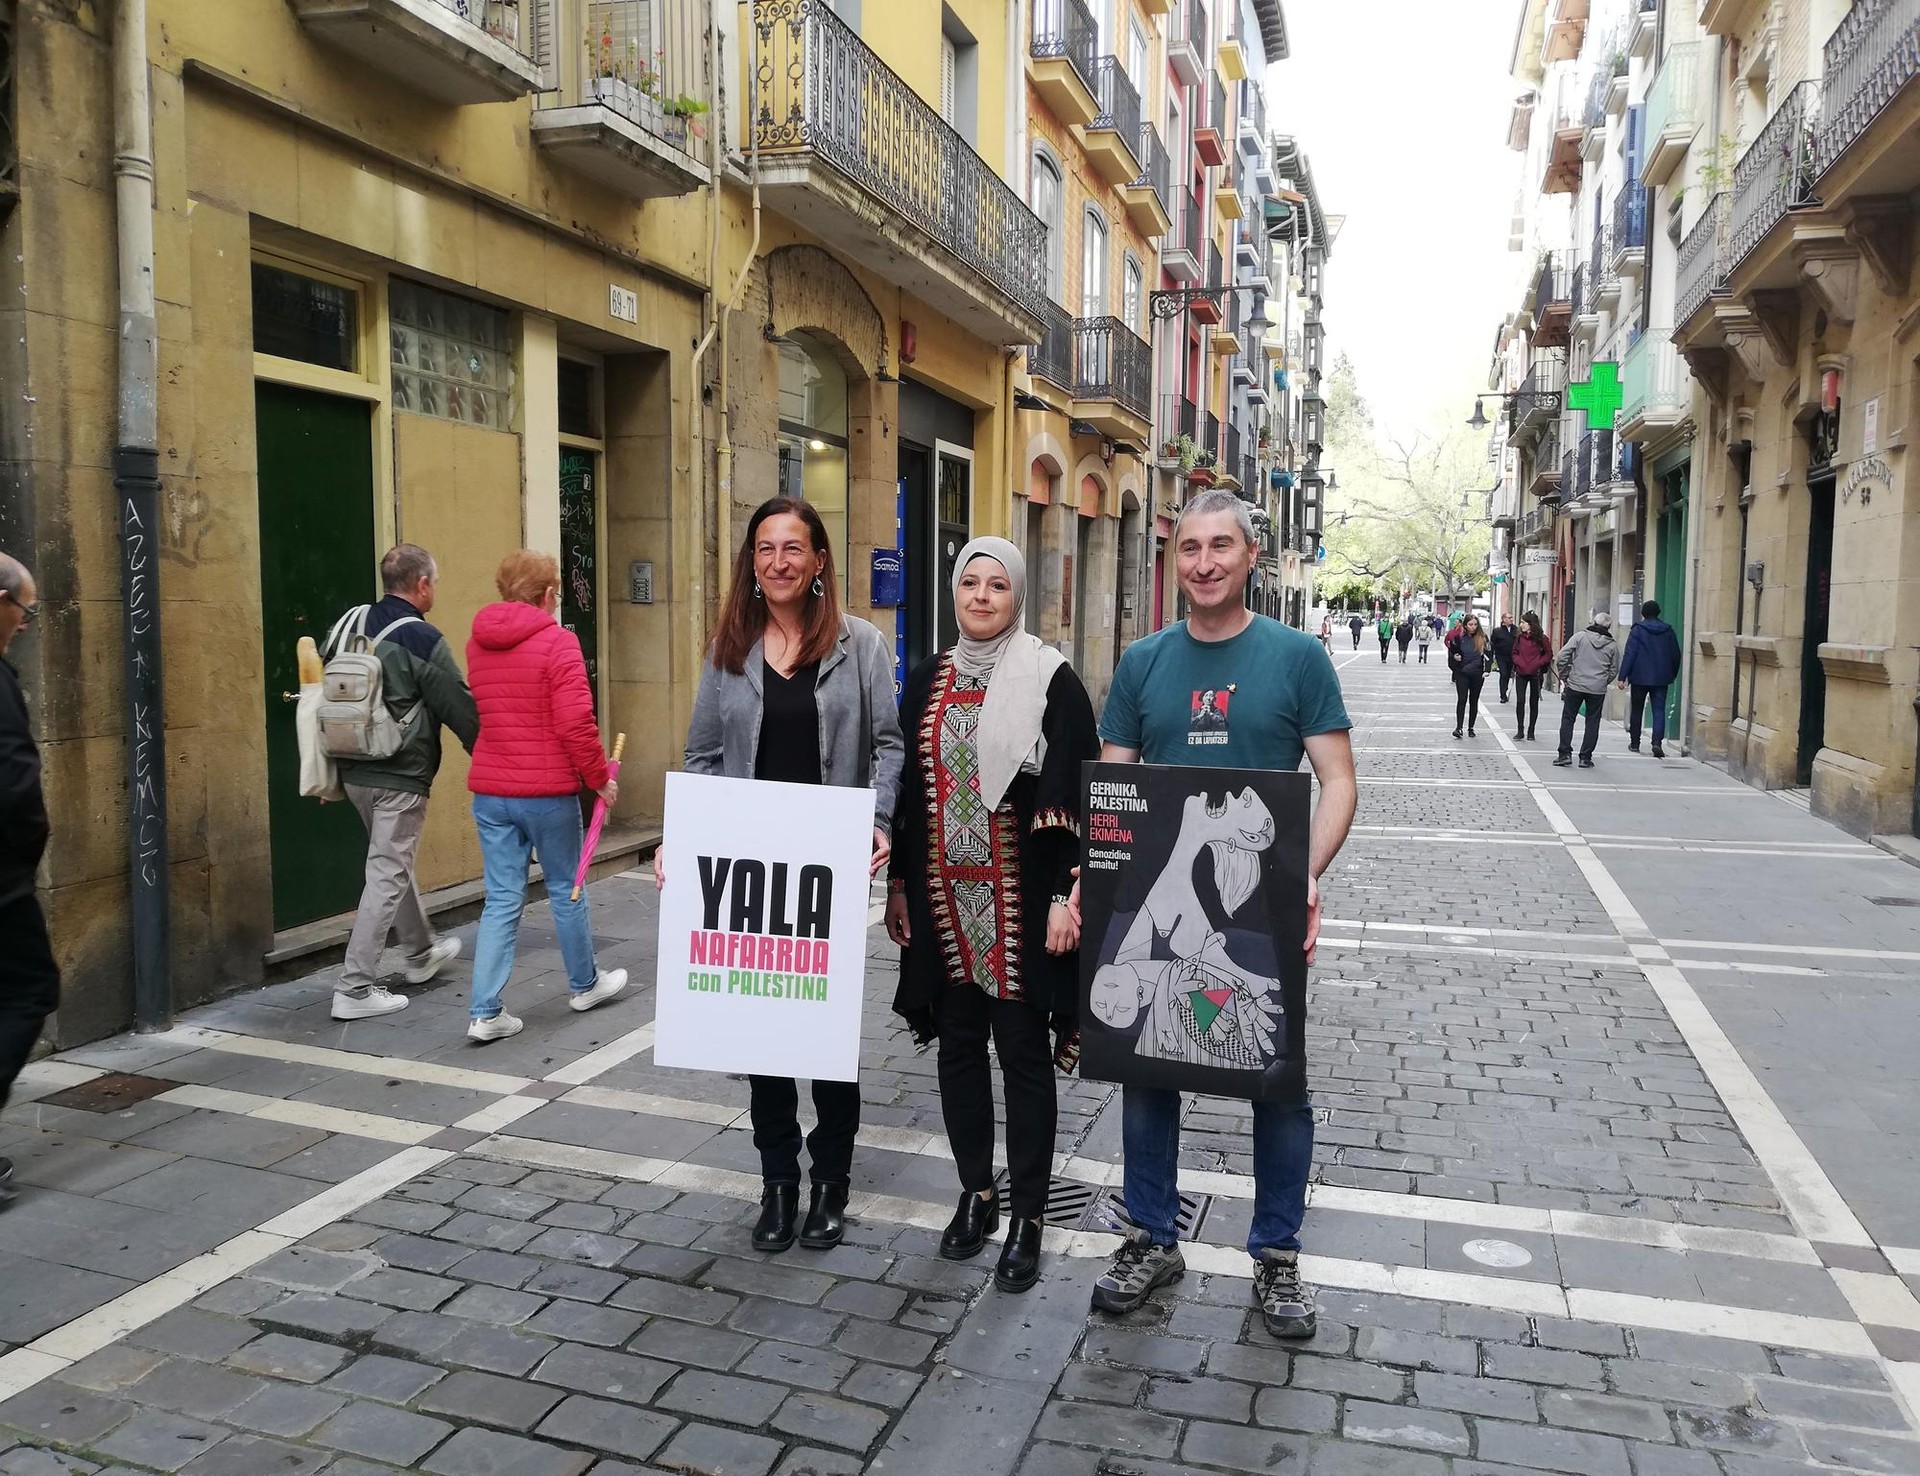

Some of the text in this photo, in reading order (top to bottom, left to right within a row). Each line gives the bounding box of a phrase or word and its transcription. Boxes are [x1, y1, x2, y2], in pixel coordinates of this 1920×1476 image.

[1090, 782, 1138, 797] GERNIKA
[1090, 796, 1148, 812] PALESTINA
[1089, 813, 1119, 828] HERRI
[1089, 827, 1133, 843] EKIMENA
[1089, 848, 1131, 860] Genozidioa
[1089, 860, 1119, 870] amaitu!
[697, 855, 833, 939] YALA
[690, 930, 829, 975] NAFARROA
[688, 969, 828, 1001] con PALESTINA
